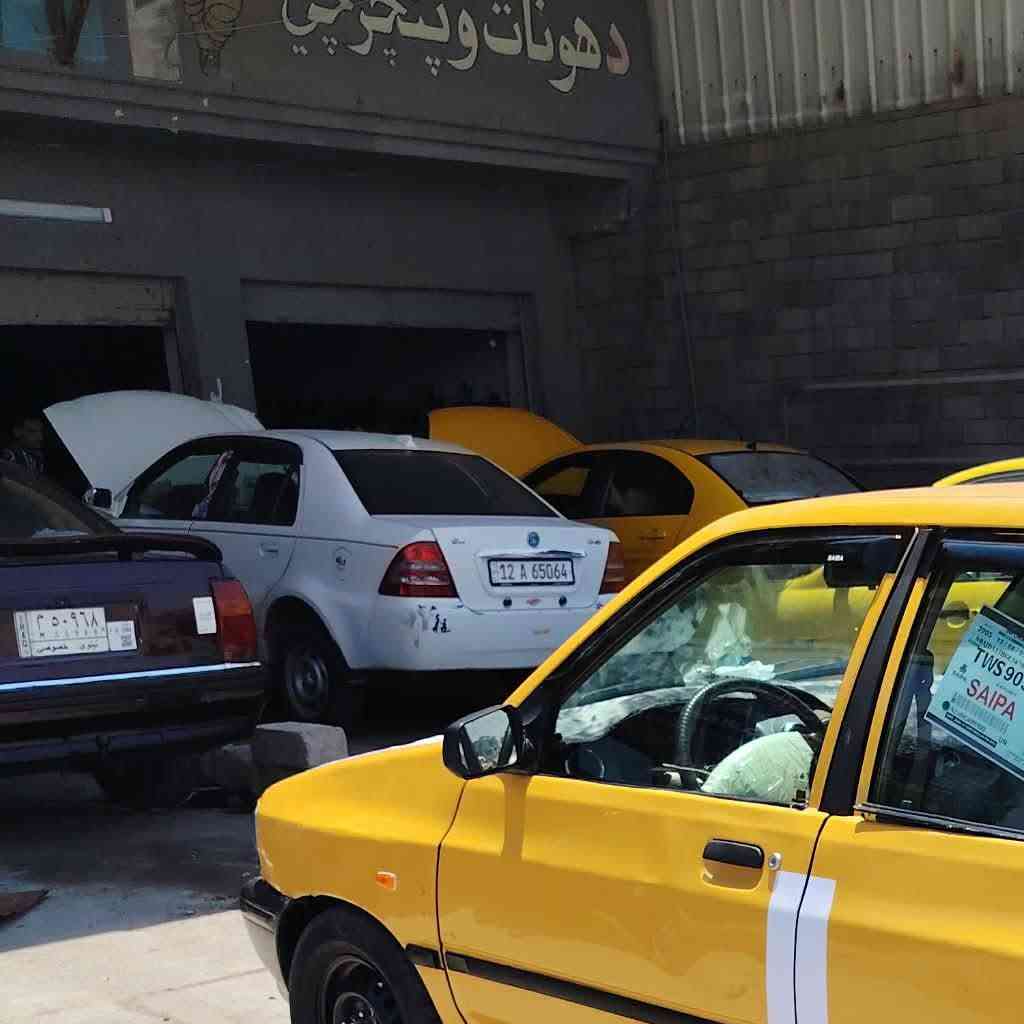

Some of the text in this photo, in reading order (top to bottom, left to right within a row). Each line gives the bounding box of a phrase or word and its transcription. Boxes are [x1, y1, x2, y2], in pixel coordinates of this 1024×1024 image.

[499, 562, 568, 581] 12 A 65064
[966, 679, 1016, 721] SAIPA
